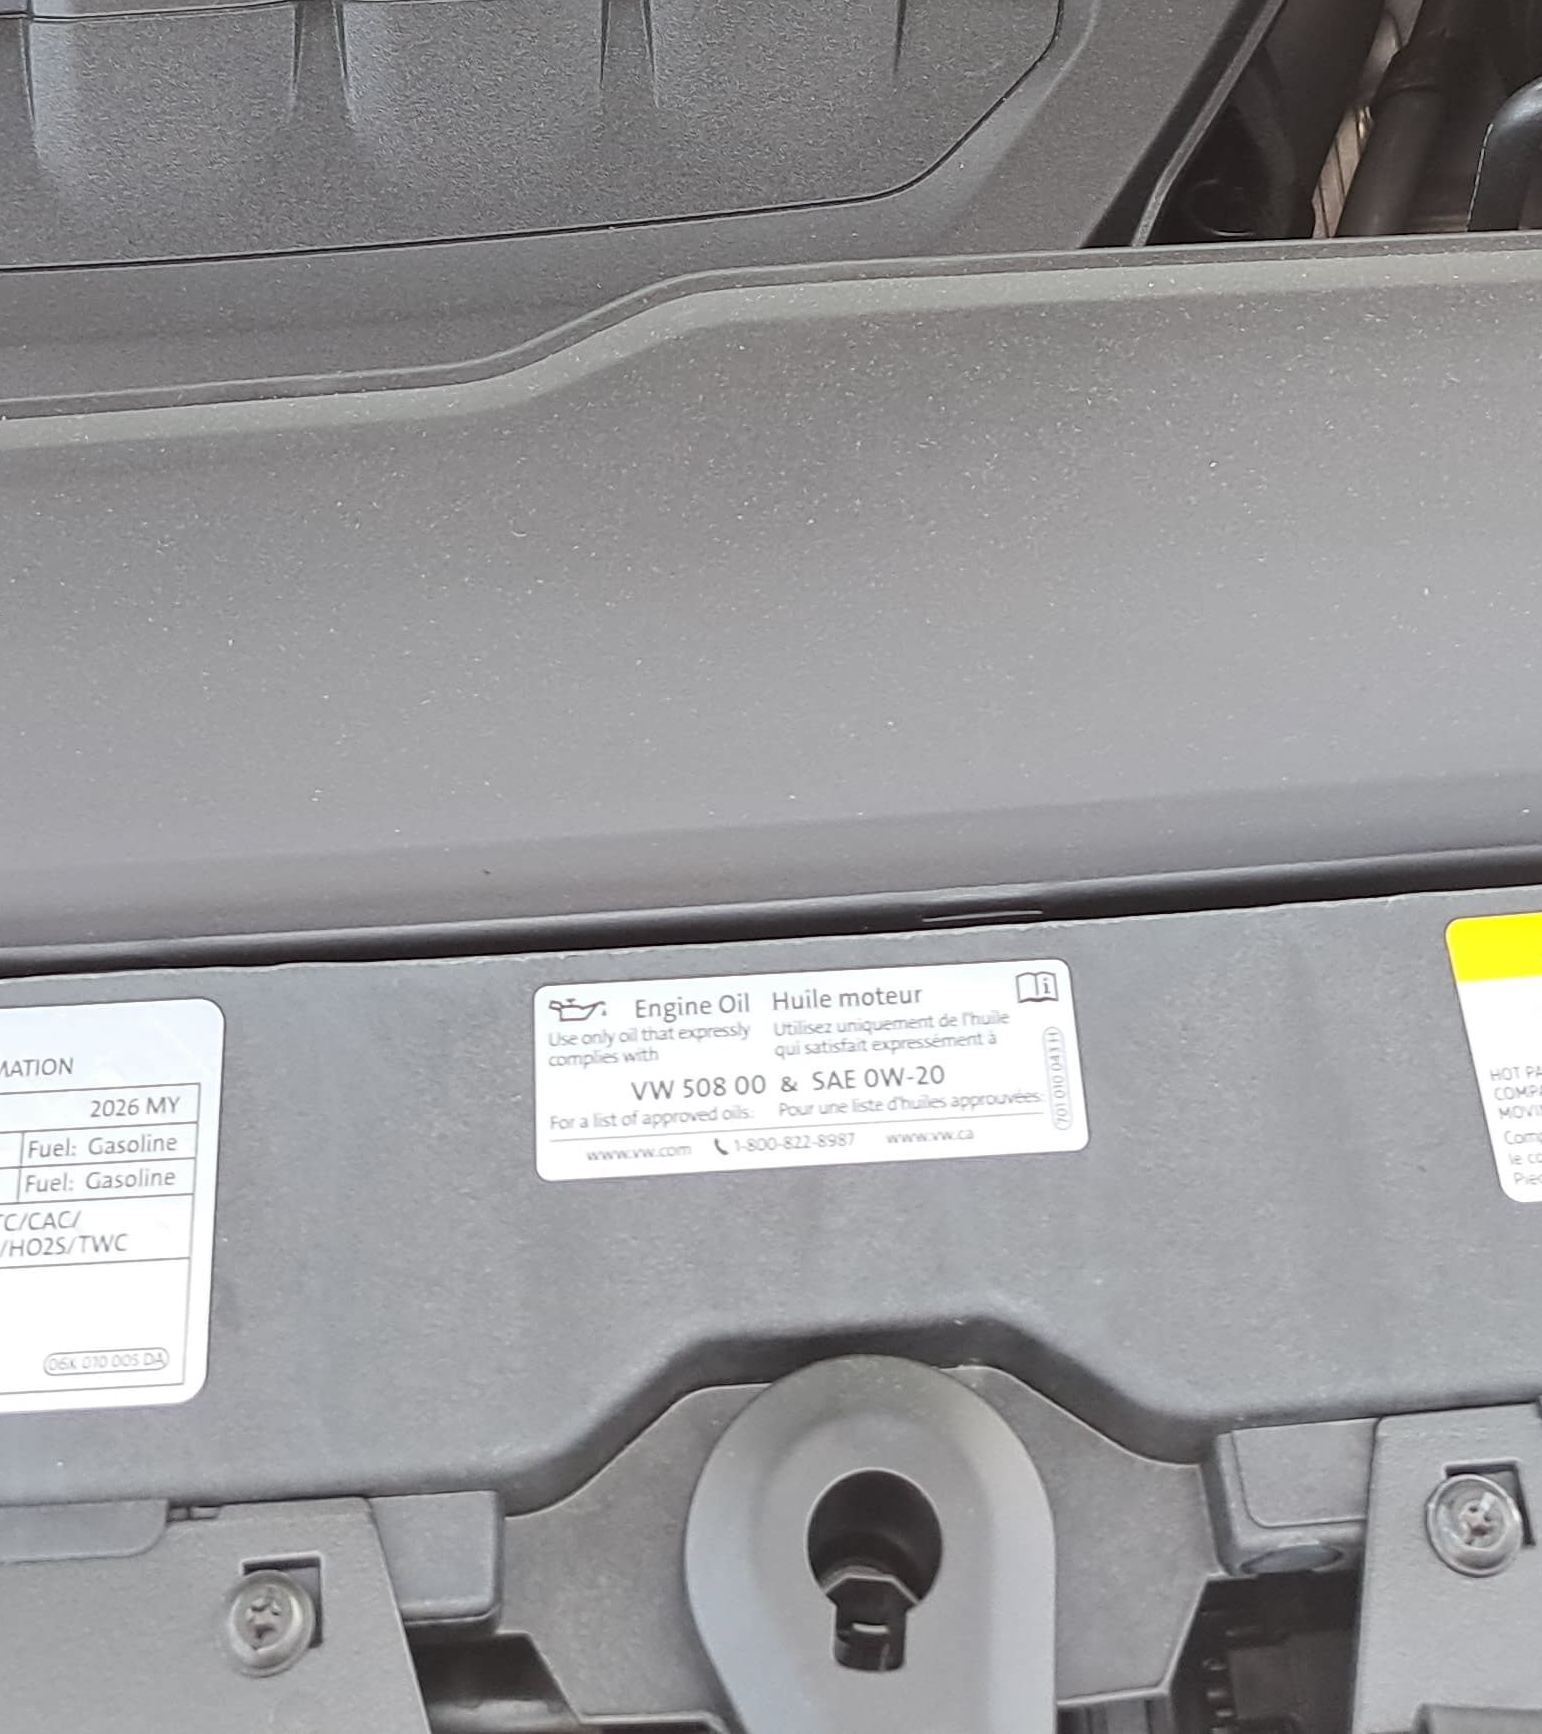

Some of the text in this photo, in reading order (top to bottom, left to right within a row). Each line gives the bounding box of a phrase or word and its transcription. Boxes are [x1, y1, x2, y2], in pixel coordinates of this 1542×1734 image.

[635, 993, 750, 1023] Engine Oil
[773, 987, 922, 1010] Huile moteur
[548, 1023, 750, 1048] Use only oil that expressly
[774, 1019, 832, 1036] Utilisez
[837, 1015, 933, 1035] uniquement
[939, 1013, 957, 1027] de
[775, 1031, 997, 1060] qui satisfait expressément à
[549, 1049, 659, 1070] complies with
[631, 1064, 945, 1101] VW 508 00 & SAE 0W-20
[1489, 1066, 1520, 1081] HOT
[90, 1096, 180, 1118] 2026 MY
[779, 1102, 813, 1117] Pour
[819, 1101, 847, 1114] une
[852, 1096, 883, 1113] liste
[550, 1115, 575, 1130] For
[579, 1118, 589, 1129] a
[593, 1112, 617, 1128] list
[621, 1110, 638, 1126] of
[642, 1108, 717, 1128] approved
[28, 1133, 177, 1159] Fuel: Gasoline
[586, 1128, 974, 1161] www.vw.com 1-800-822-8987 www.vw.ca
[1509, 1151, 1523, 1165] le
[24, 1167, 176, 1194] Fuel: Gasoline
